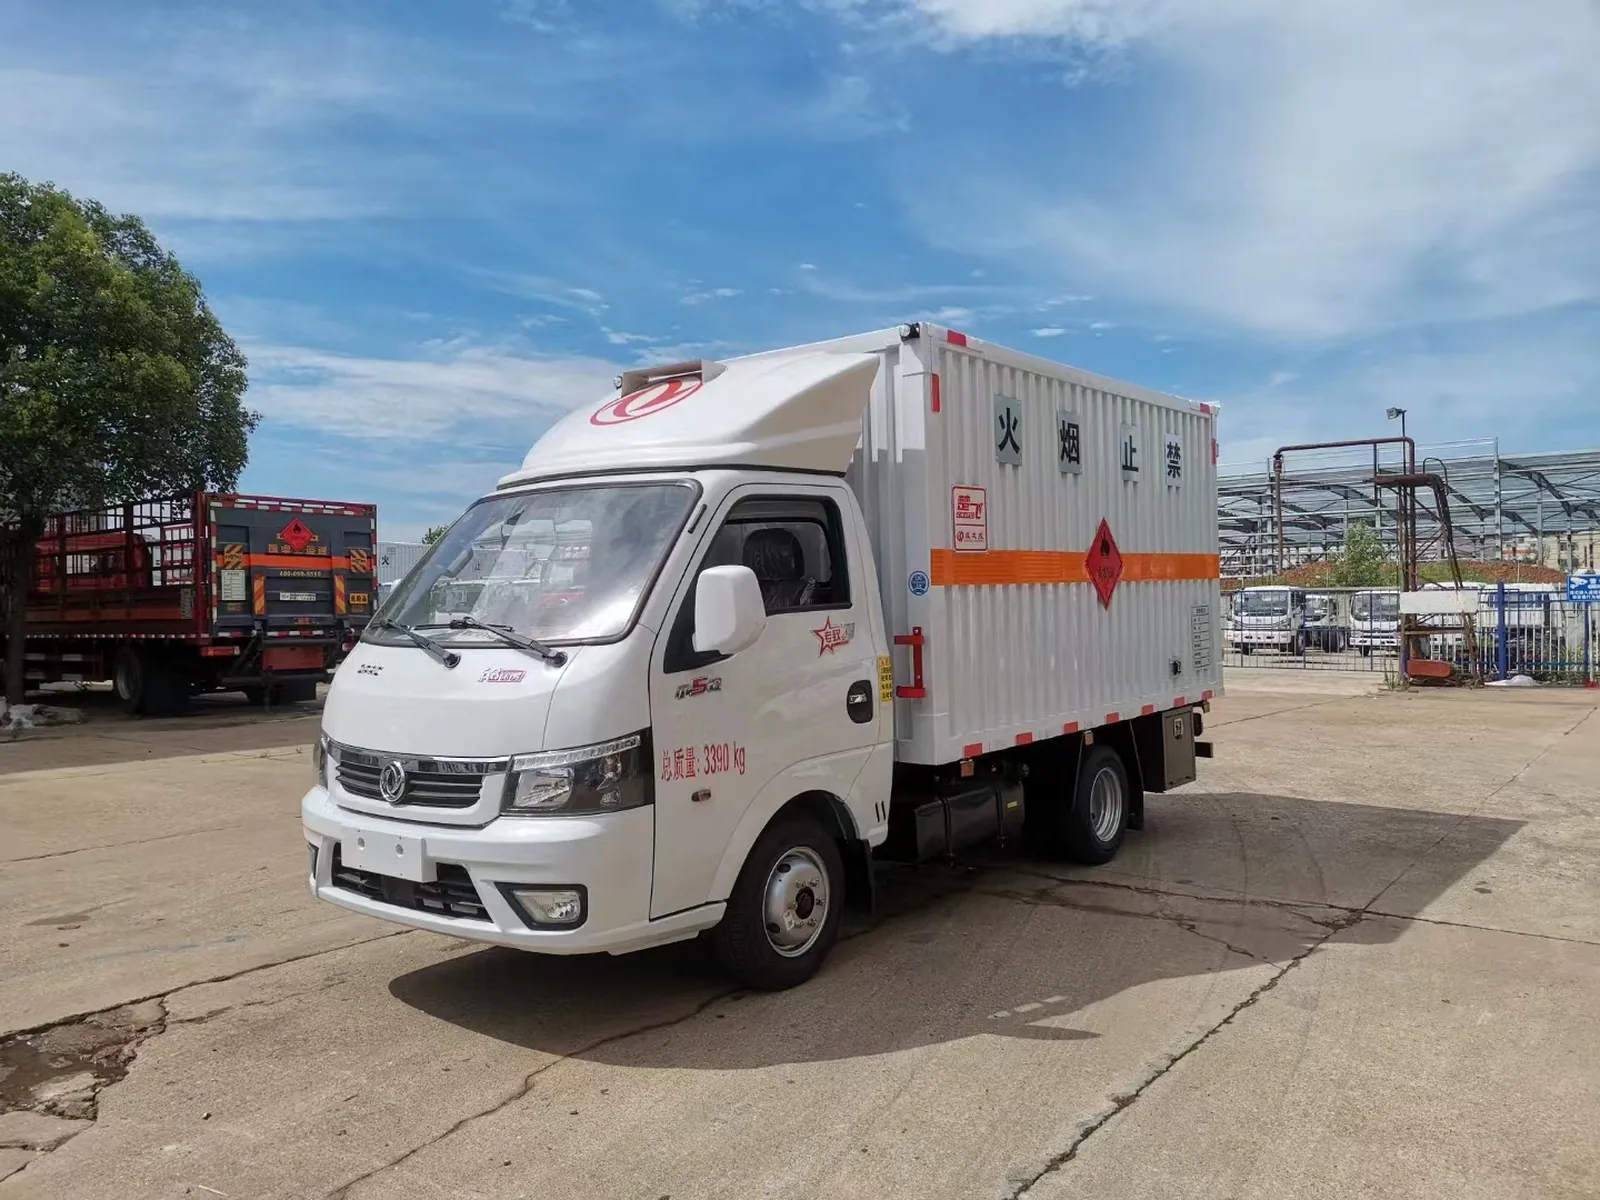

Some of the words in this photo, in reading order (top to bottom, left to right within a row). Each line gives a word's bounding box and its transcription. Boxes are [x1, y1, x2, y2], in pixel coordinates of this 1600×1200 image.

[998, 407, 1020, 454] 火
[1060, 420, 1080, 465] 烟
[1122, 434, 1139, 472] 止
[1166, 441, 1181, 478] 禁
[703, 743, 730, 775] 3390
[733, 741, 746, 775] kg
